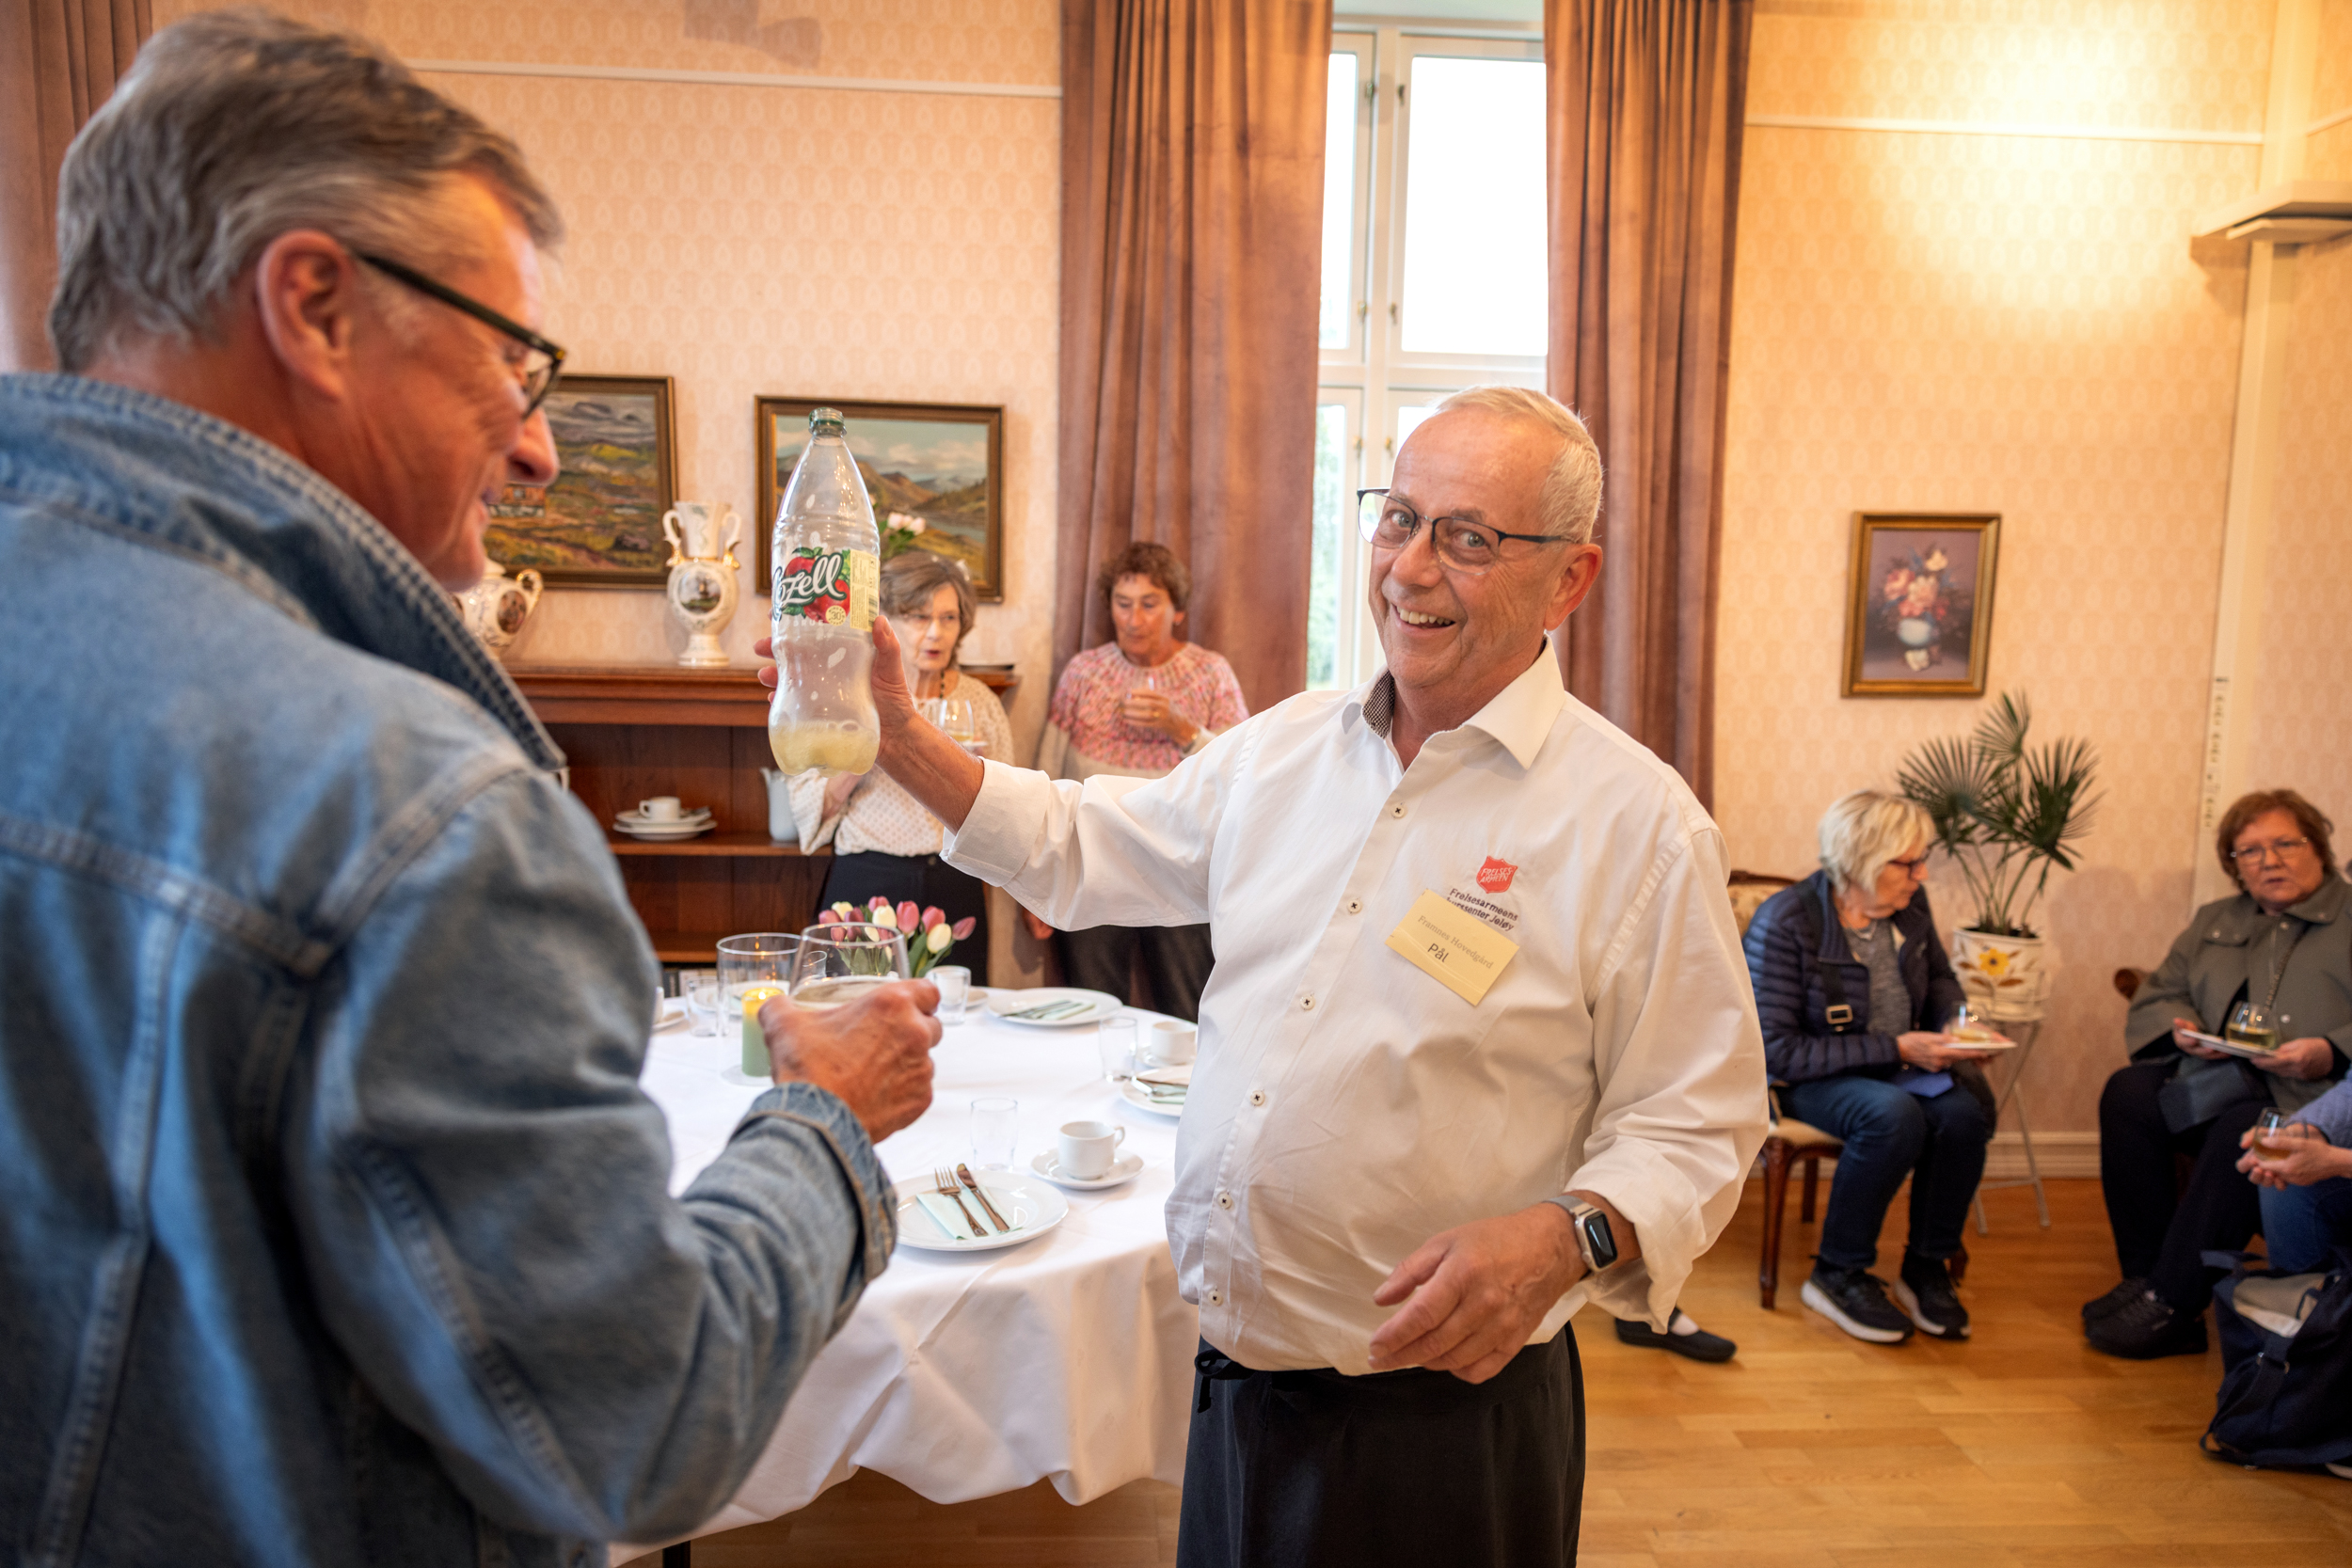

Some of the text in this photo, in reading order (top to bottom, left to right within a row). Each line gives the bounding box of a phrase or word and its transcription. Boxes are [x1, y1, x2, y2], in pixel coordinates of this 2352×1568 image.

[1449, 888, 1518, 922] Frelsesarmeens
[1418, 915, 1495, 970] Framnes Hovedgård
[1427, 942, 1450, 963] Pål
